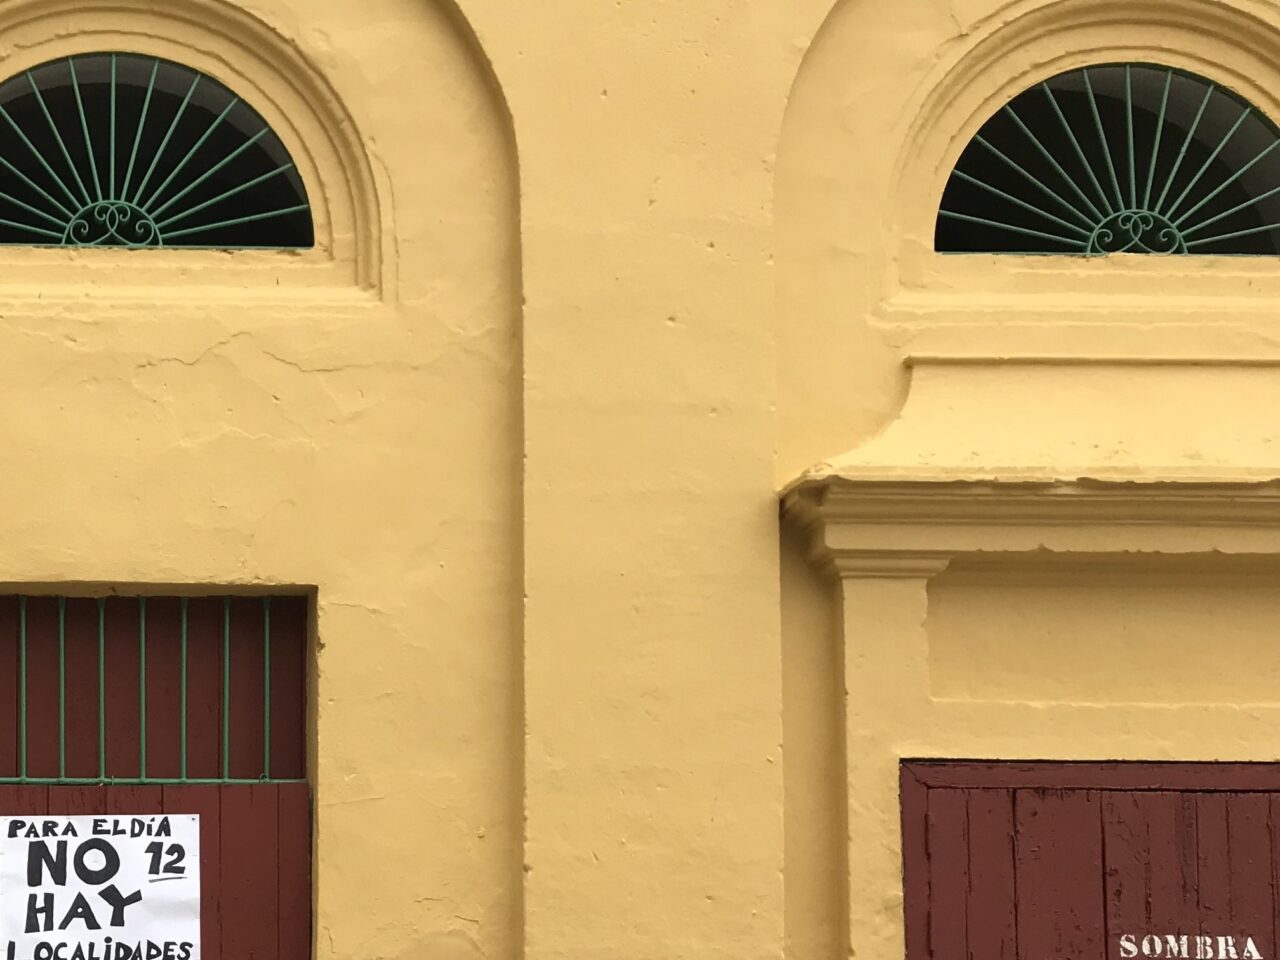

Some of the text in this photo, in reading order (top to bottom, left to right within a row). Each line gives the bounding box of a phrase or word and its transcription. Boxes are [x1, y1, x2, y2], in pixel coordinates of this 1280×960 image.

[7, 819, 78, 838] PARA
[92, 818, 127, 836] EL
[26, 837, 186, 887] NO 12
[24, 884, 143, 934] HAY
[1119, 934, 1264, 960] SOMBRA
